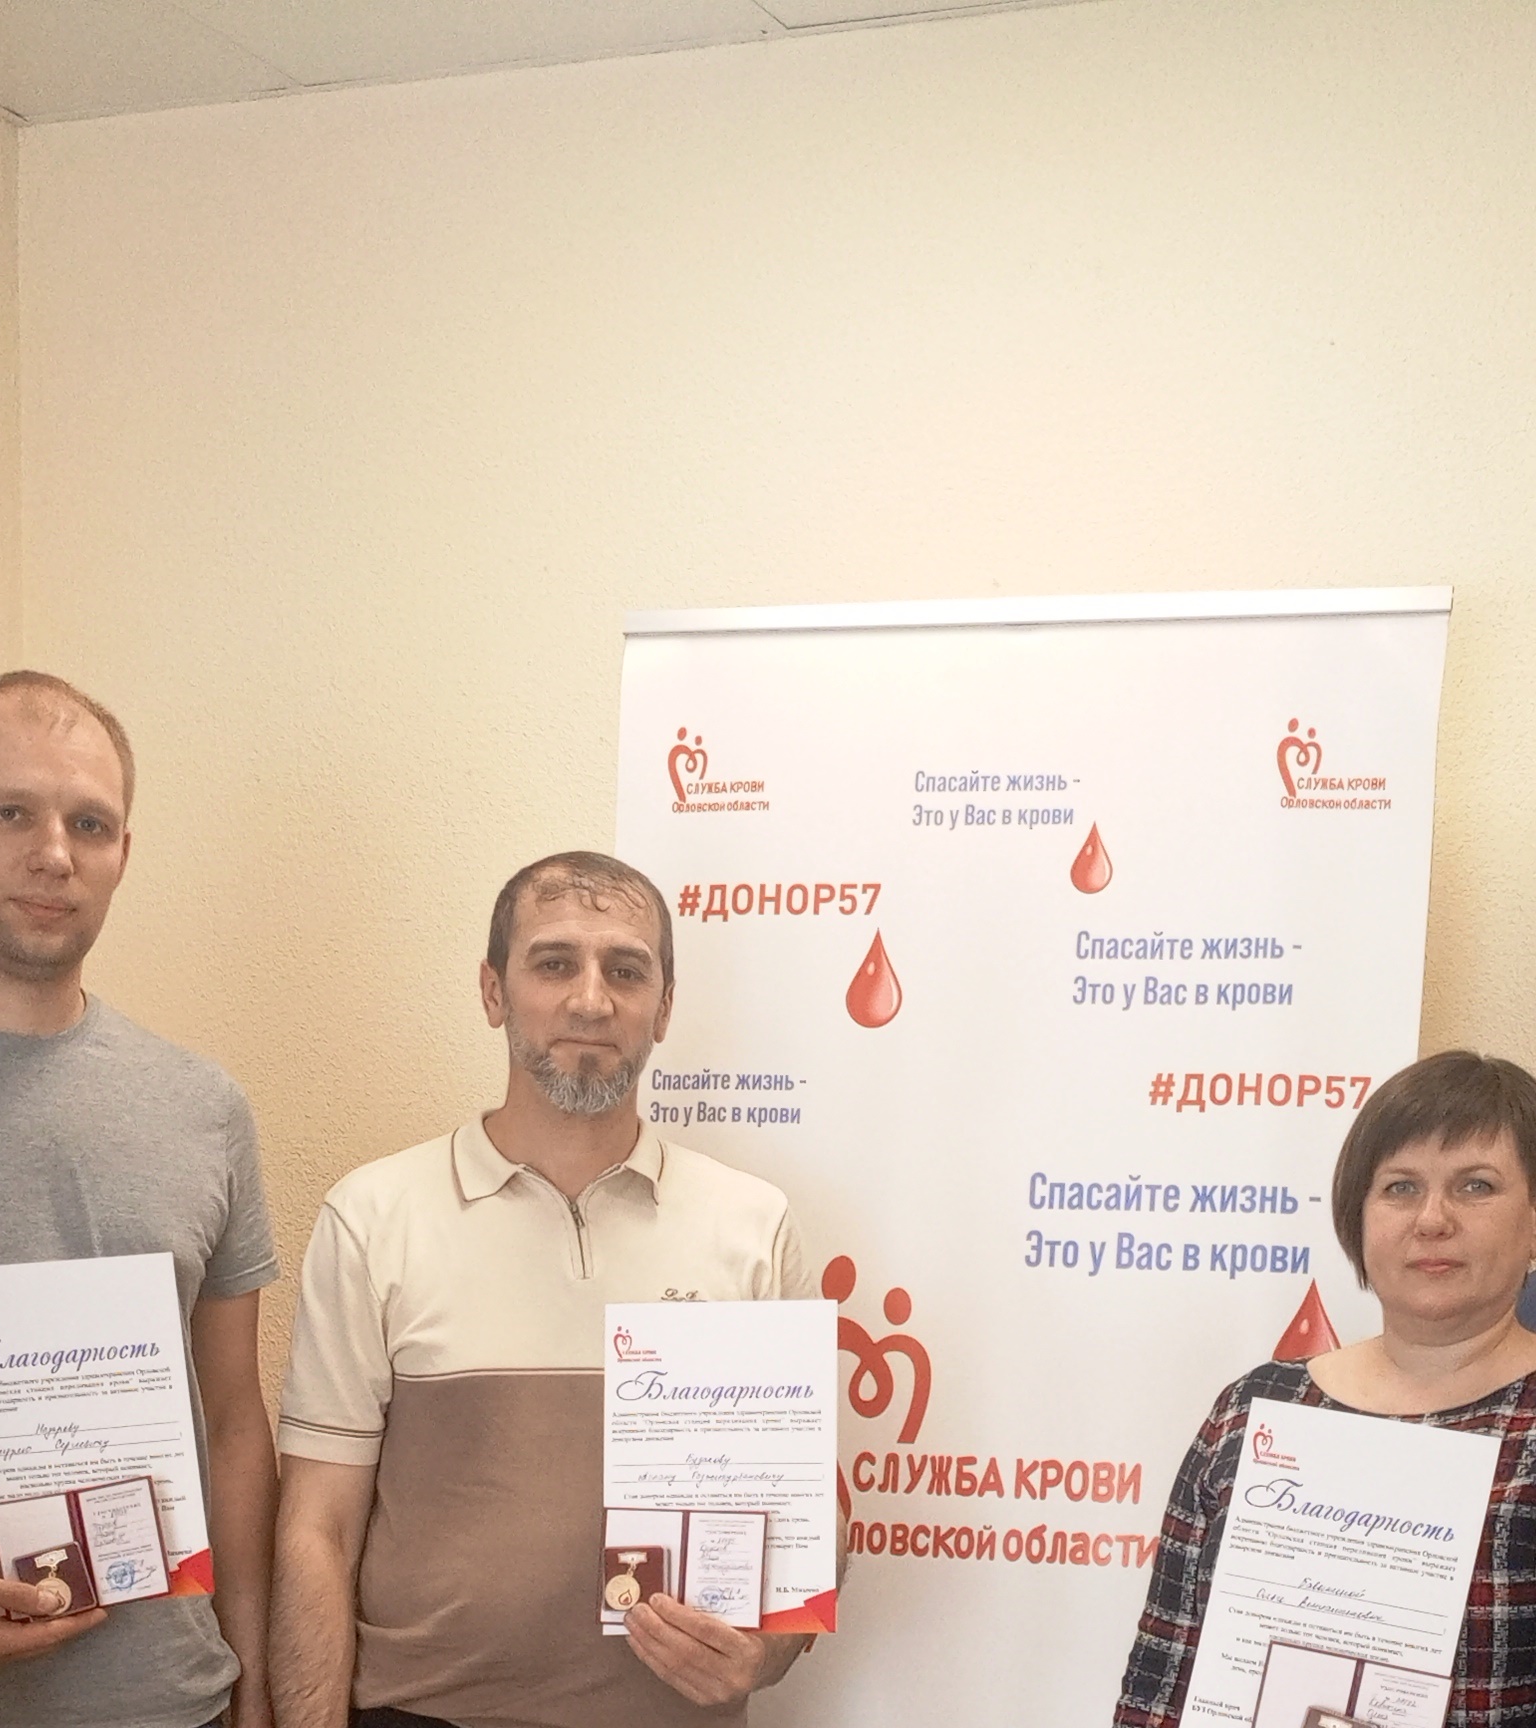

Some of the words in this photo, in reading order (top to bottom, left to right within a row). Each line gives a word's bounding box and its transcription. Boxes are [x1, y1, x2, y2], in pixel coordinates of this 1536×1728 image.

[686, 781, 727, 794] СЛУЖБА
[730, 780, 764, 793] КРОВИ
[915, 770, 1001, 792] Спасайте
[1006, 774, 1067, 791] жизнь
[1297, 777, 1344, 791] СЛУЖБА
[1347, 777, 1386, 791] КРОВИ
[672, 801, 725, 814] Орловской
[727, 799, 769, 812] области
[913, 804, 944, 826] Это
[949, 810, 959, 831] у
[965, 804, 996, 825] Вас
[1002, 809, 1012, 824] в
[1017, 808, 1074, 830] крови
[1280, 796, 1341, 809] Орловской
[1343, 797, 1391, 810] области
[678, 883, 881, 922] #ДОНОР57
[1075, 930, 1193, 960] Спасайте
[1201, 937, 1284, 959] жизнь
[1073, 975, 1114, 1005] Это
[1122, 984, 1136, 1011] у
[1143, 976, 1187, 1005] Вас
[1194, 984, 1209, 1005] в
[1216, 983, 1293, 1011] крови
[652, 1068, 730, 1091] Спасайте
[735, 1073, 794, 1091] жизнь
[1149, 1072, 1372, 1113] #ДОНОР57
[650, 1101, 679, 1123] Это
[683, 1106, 693, 1127] у
[697, 1101, 726, 1122] Вас
[732, 1107, 741, 1122] в
[747, 1106, 801, 1127] крови
[1028, 1172, 1180, 1213] Спасайте
[1189, 1184, 1299, 1215] жизнь
[1024, 1229, 1079, 1268] Это
[1088, 1241, 1107, 1277] у
[1115, 1232, 1172, 1271] Вас
[1182, 1243, 1200, 1272] в
[1210, 1243, 1310, 1280] крови
[616, 1370, 814, 1408] Благодарность
[852, 1451, 1004, 1499] СЛУЖБА
[1014, 1458, 1142, 1505] КРОВИ
[1244, 1478, 1455, 1543] Благодарность
[848, 1521, 996, 1560] ловской
[1002, 1524, 1160, 1569] области
